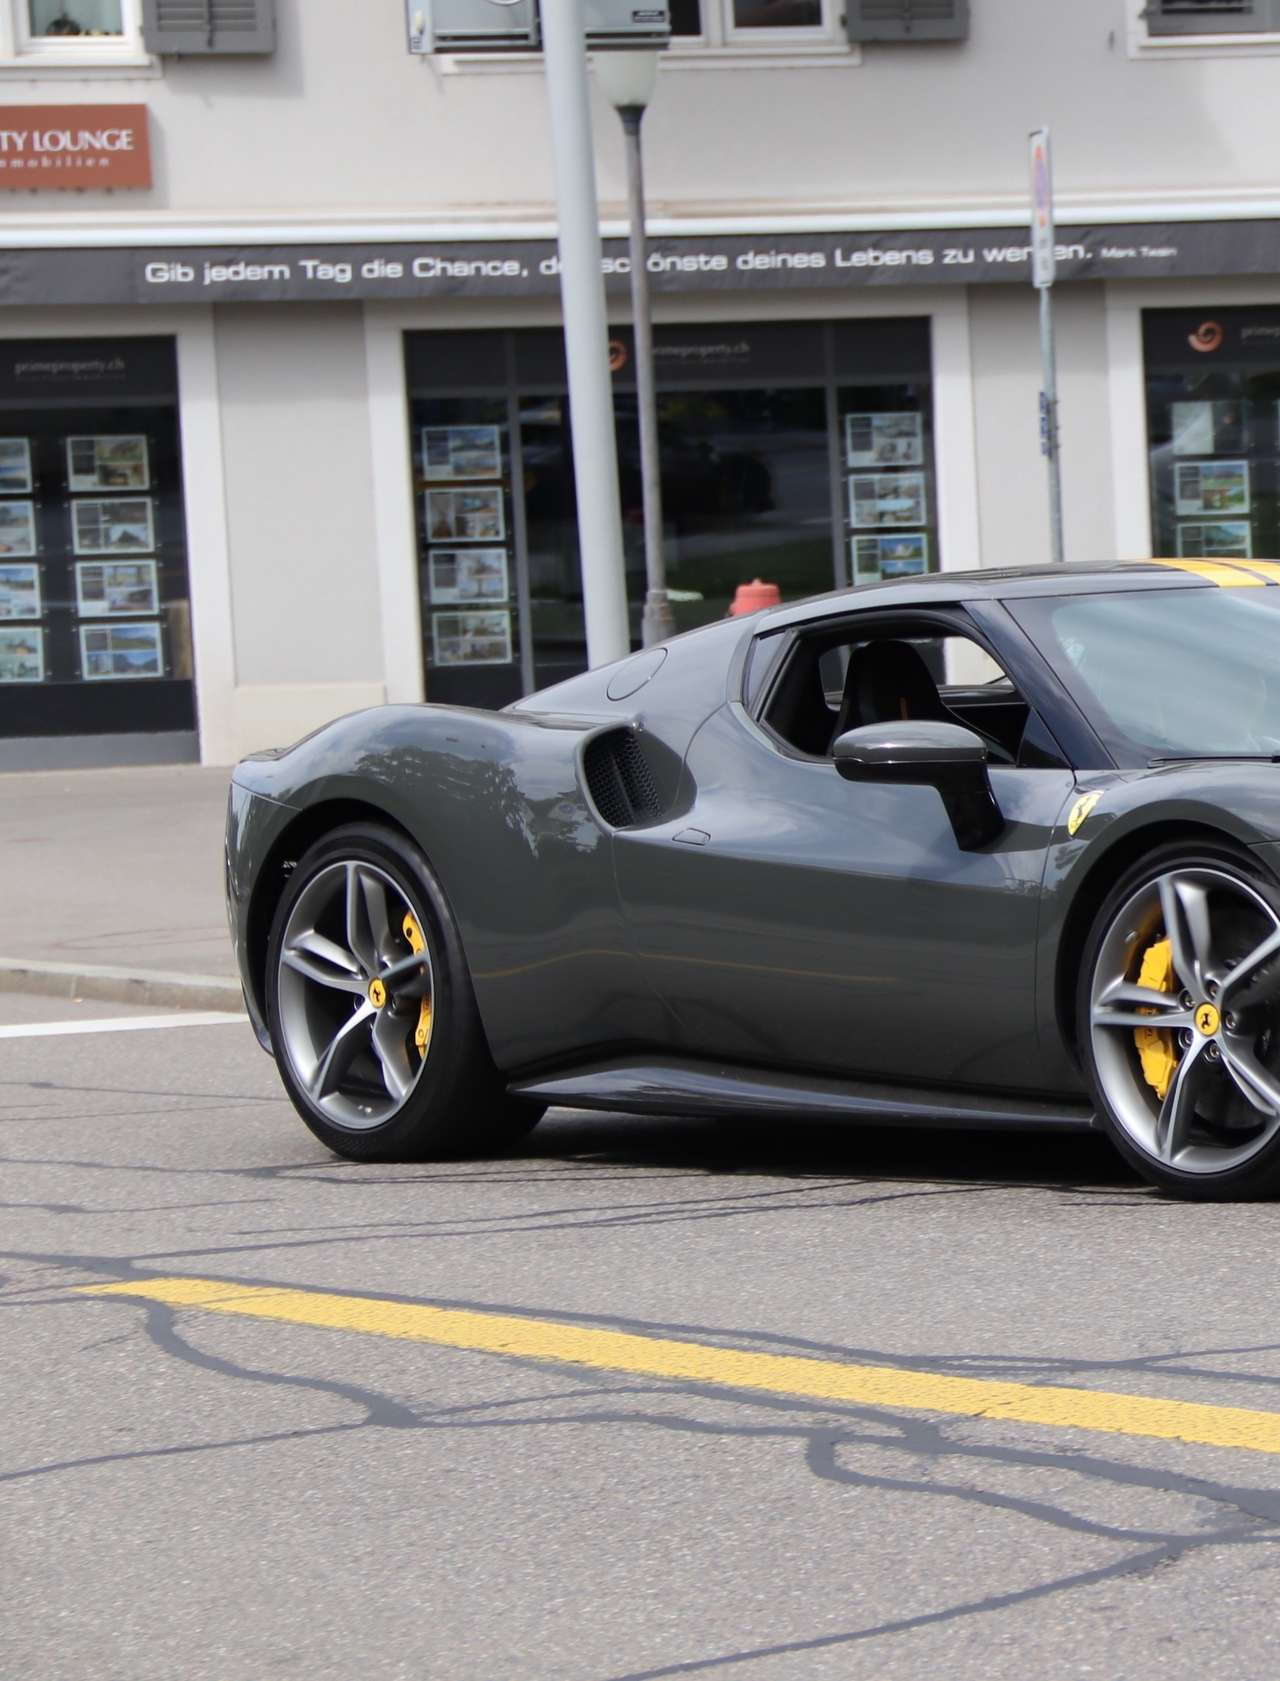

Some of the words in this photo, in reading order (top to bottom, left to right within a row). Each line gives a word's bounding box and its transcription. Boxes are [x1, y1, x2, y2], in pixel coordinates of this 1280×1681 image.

[33, 129, 134, 151] LOUNGE
[145, 262, 194, 283] Gib
[203, 261, 290, 285] jedem
[298, 259, 352, 282] Tag
[361, 258, 403, 279] die
[412, 257, 528, 278] Chance,
[601, 252, 729, 273] scönste
[735, 250, 827, 270] deines
[834, 248, 935, 267] Lebens
[942, 248, 976, 264] zu
[982, 243, 1094, 263] weren.
[1101, 246, 1137, 259] Mark
[1139, 245, 1178, 258] Twain
